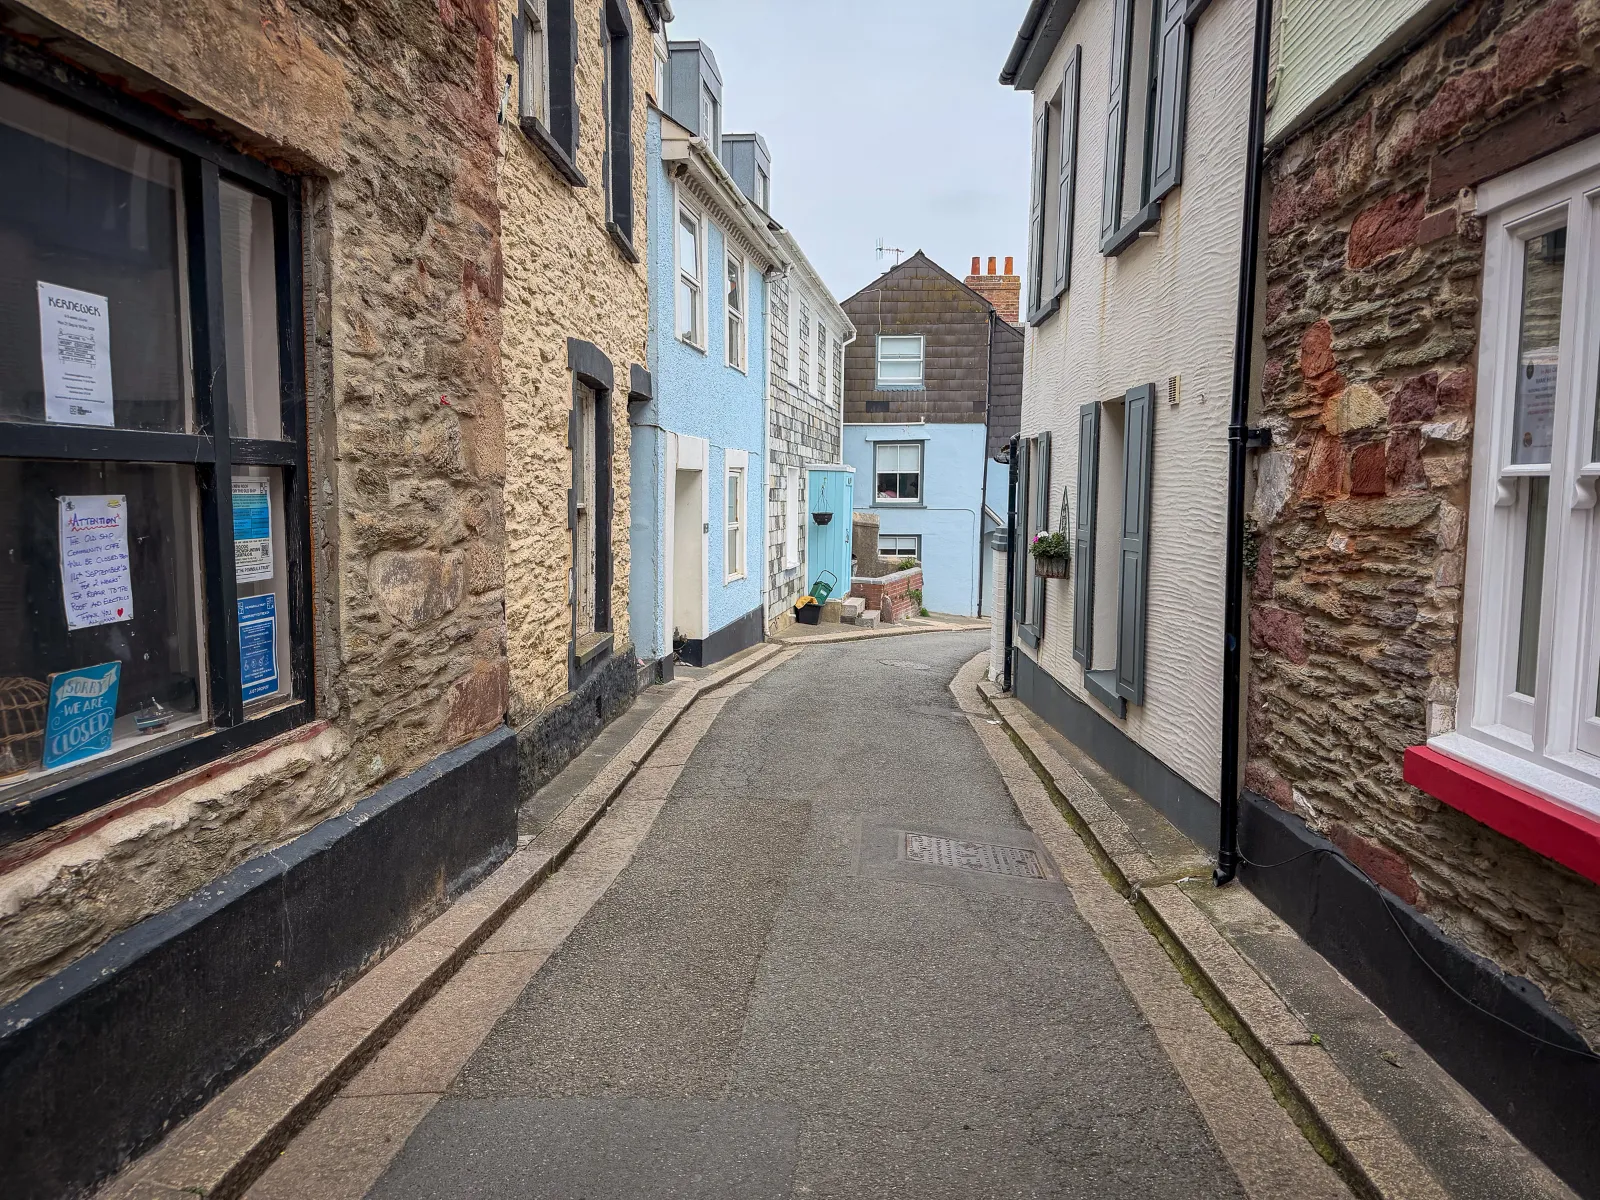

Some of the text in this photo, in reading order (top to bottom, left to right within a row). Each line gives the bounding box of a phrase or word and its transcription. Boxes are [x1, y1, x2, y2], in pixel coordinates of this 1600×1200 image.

[48, 296, 101, 317] KERNEWEK
[96, 555, 119, 564] CLOSED
[66, 680, 104, 694] SORRY
[63, 697, 103, 716] WE ARE
[52, 712, 109, 756] CLOSED
